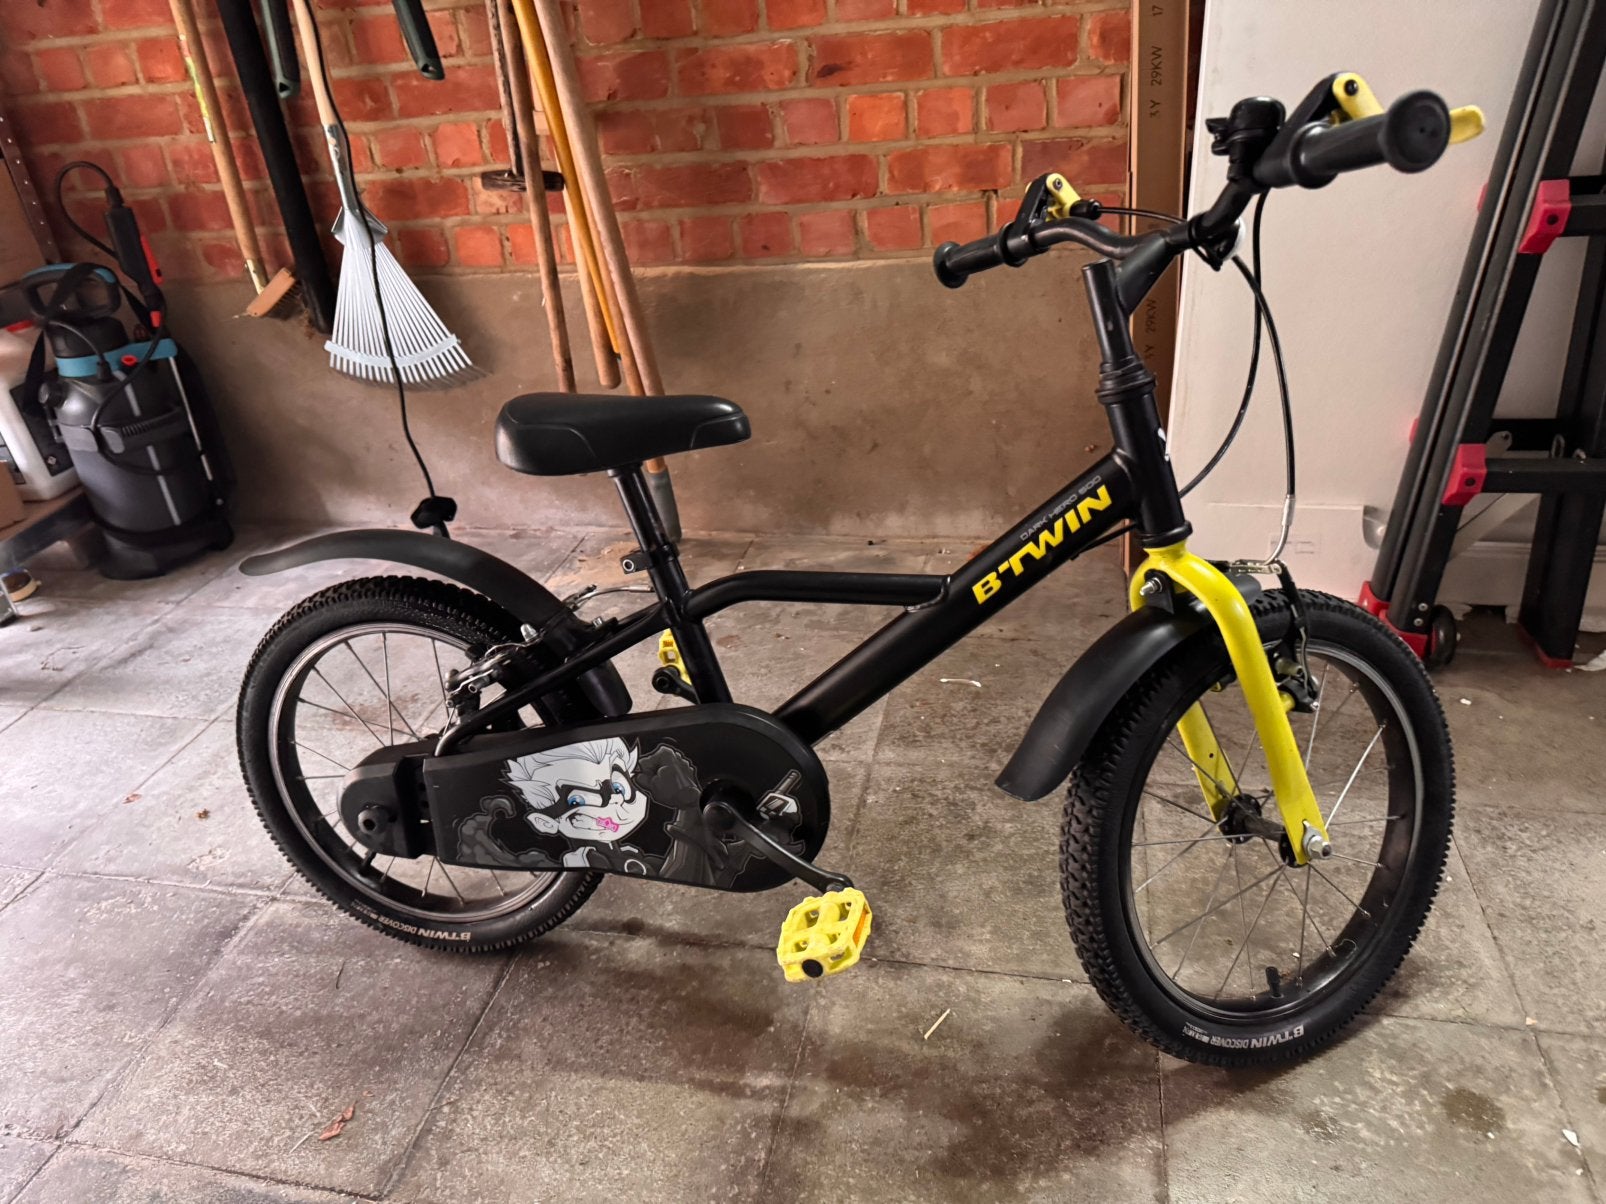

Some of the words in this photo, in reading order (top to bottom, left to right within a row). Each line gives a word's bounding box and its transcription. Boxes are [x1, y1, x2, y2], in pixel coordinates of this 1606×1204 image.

[1151, 5, 1163, 17] 17
[1150, 45, 1163, 86] 29KW
[1019, 518, 1048, 541] DARK
[1048, 494, 1078, 519] HERO
[377, 915, 417, 934] DISCOVER
[1210, 1035, 1249, 1049] DISCOVER
